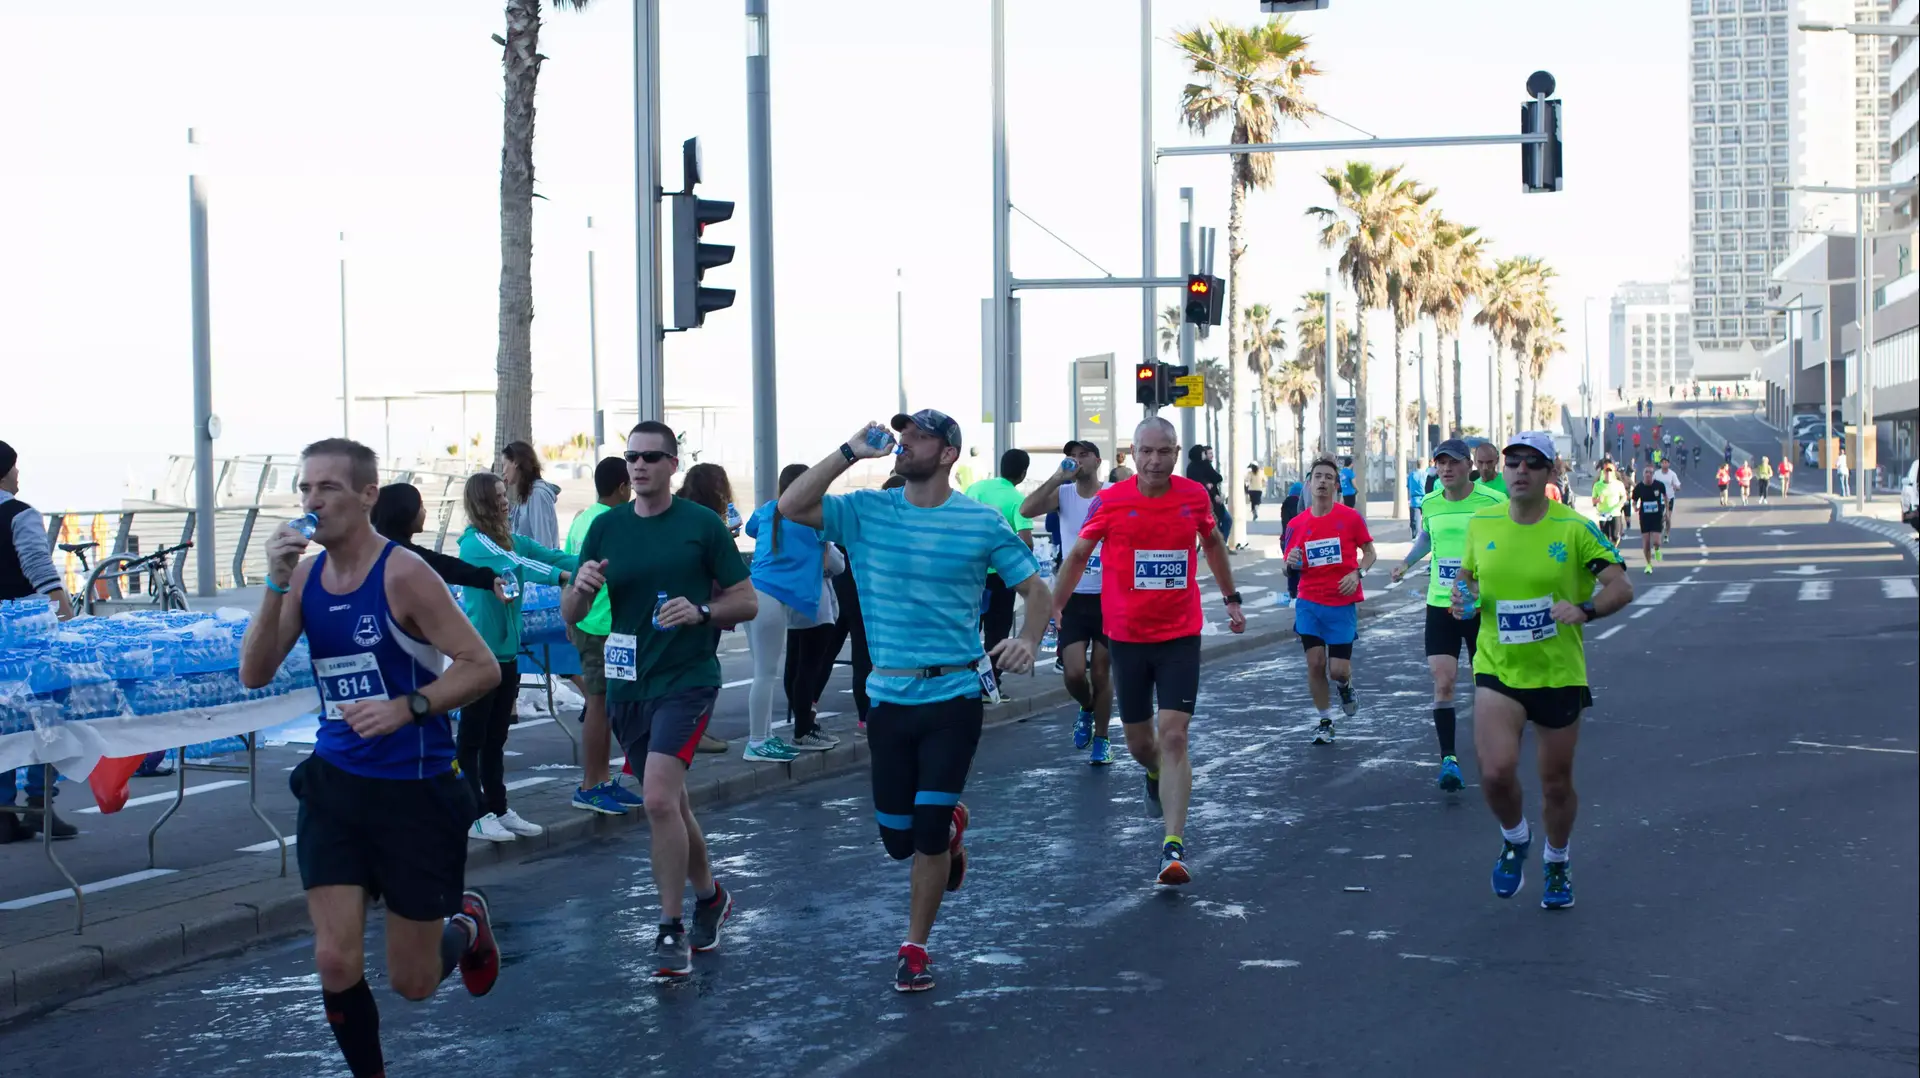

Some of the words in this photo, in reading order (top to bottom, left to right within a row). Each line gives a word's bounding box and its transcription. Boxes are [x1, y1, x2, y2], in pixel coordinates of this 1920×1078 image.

[1308, 550, 1315, 558] A
[1319, 546, 1335, 557] 954
[1137, 564, 1147, 575] A
[1152, 563, 1182, 576] 1298
[1440, 567, 1446, 577] A
[1500, 616, 1510, 628] A
[1519, 612, 1546, 628] 437
[609, 648, 629, 663] 975
[337, 675, 371, 697] 814
[985, 675, 995, 689] A
